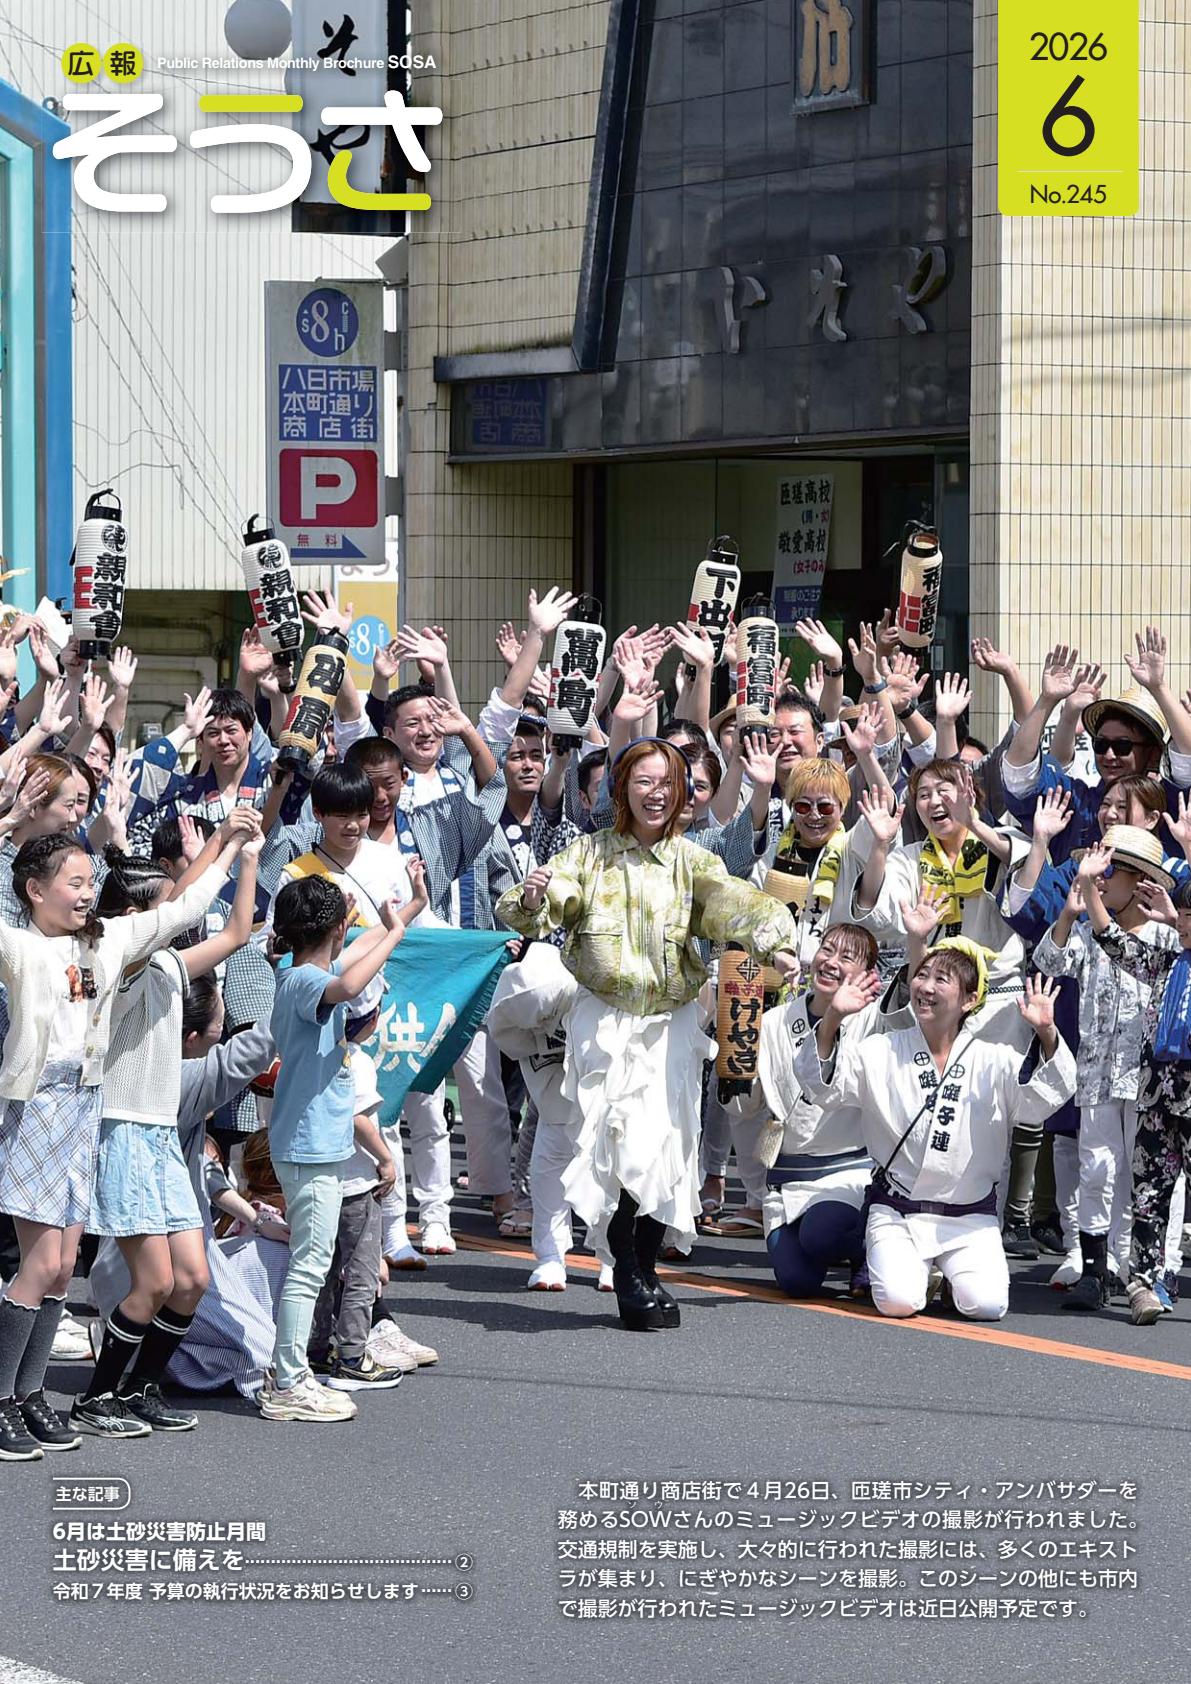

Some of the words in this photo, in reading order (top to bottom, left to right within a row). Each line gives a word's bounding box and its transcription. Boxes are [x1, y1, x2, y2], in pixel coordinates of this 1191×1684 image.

[282, 368, 375, 392] 八日市場
[282, 393, 374, 416] 本町通り
[283, 417, 374, 439] 商店街
[300, 456, 357, 520] P
[297, 534, 338, 547] 無料
[727, 997, 762, 1075] けやき
